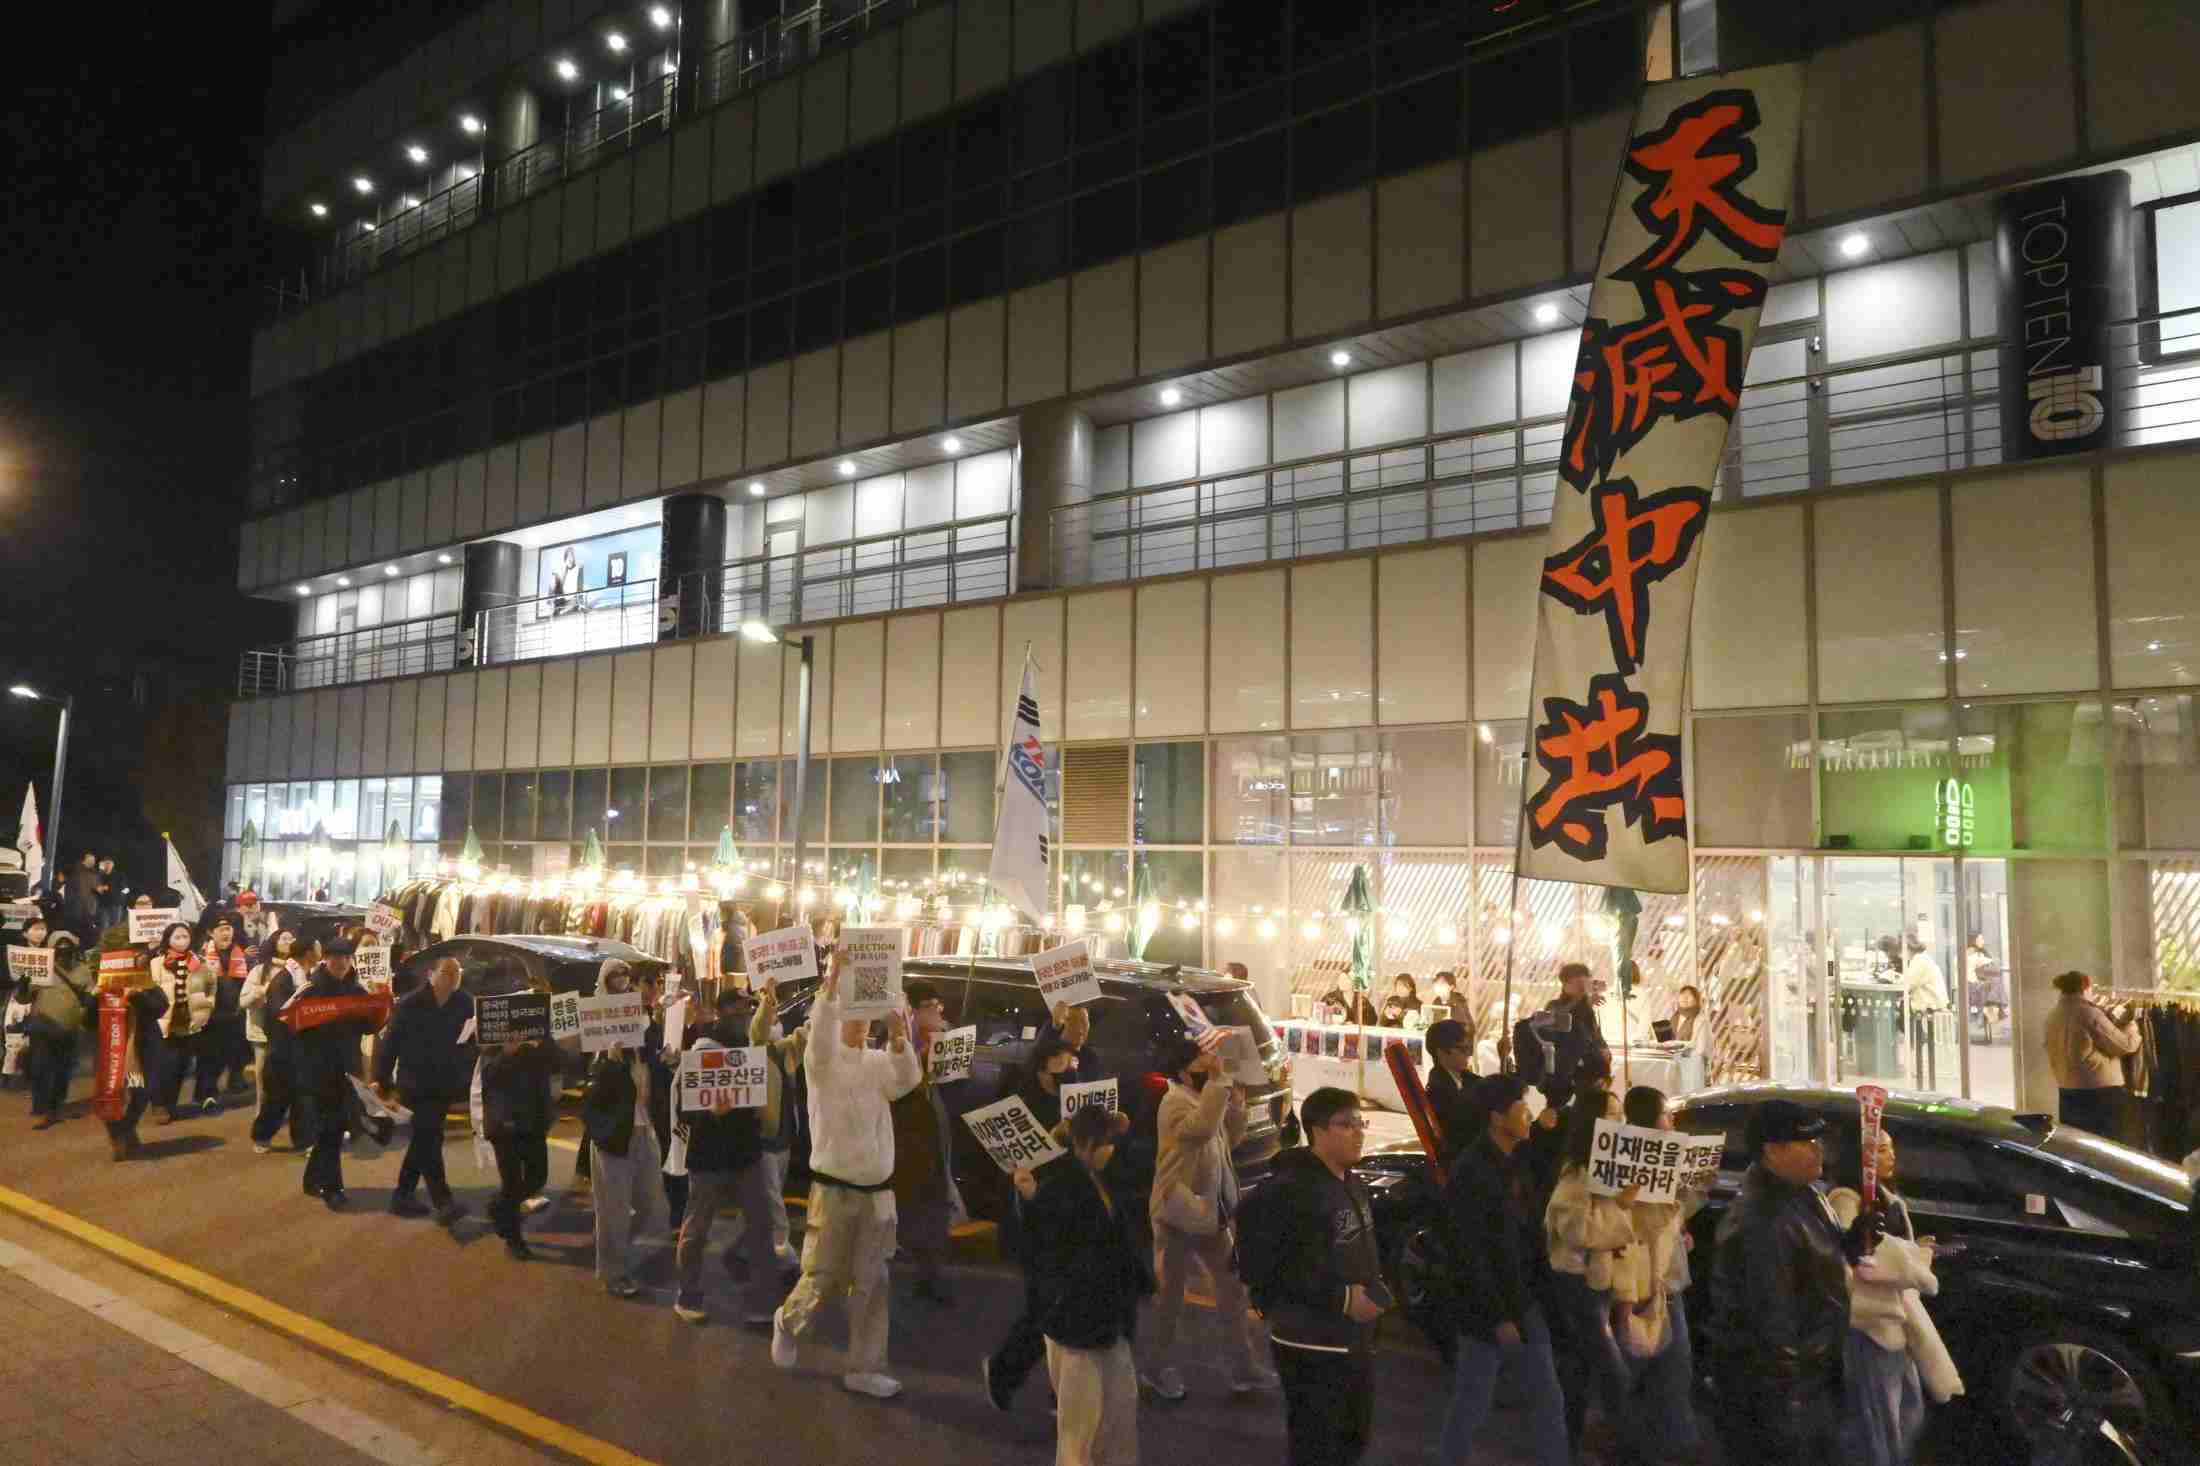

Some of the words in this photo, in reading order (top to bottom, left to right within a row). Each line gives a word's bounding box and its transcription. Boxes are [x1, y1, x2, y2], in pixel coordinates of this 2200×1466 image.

[2021, 195, 2073, 377] TOPTEN
[2027, 365, 2104, 441] 10
[1529, 88, 1787, 861] 天滅中共
[848, 943, 896, 952] ELECTION
[684, 1067, 764, 1089] 중국공산당
[1598, 1132, 1681, 1168] 이재명을
[1592, 1159, 1675, 1194] 재판하라
